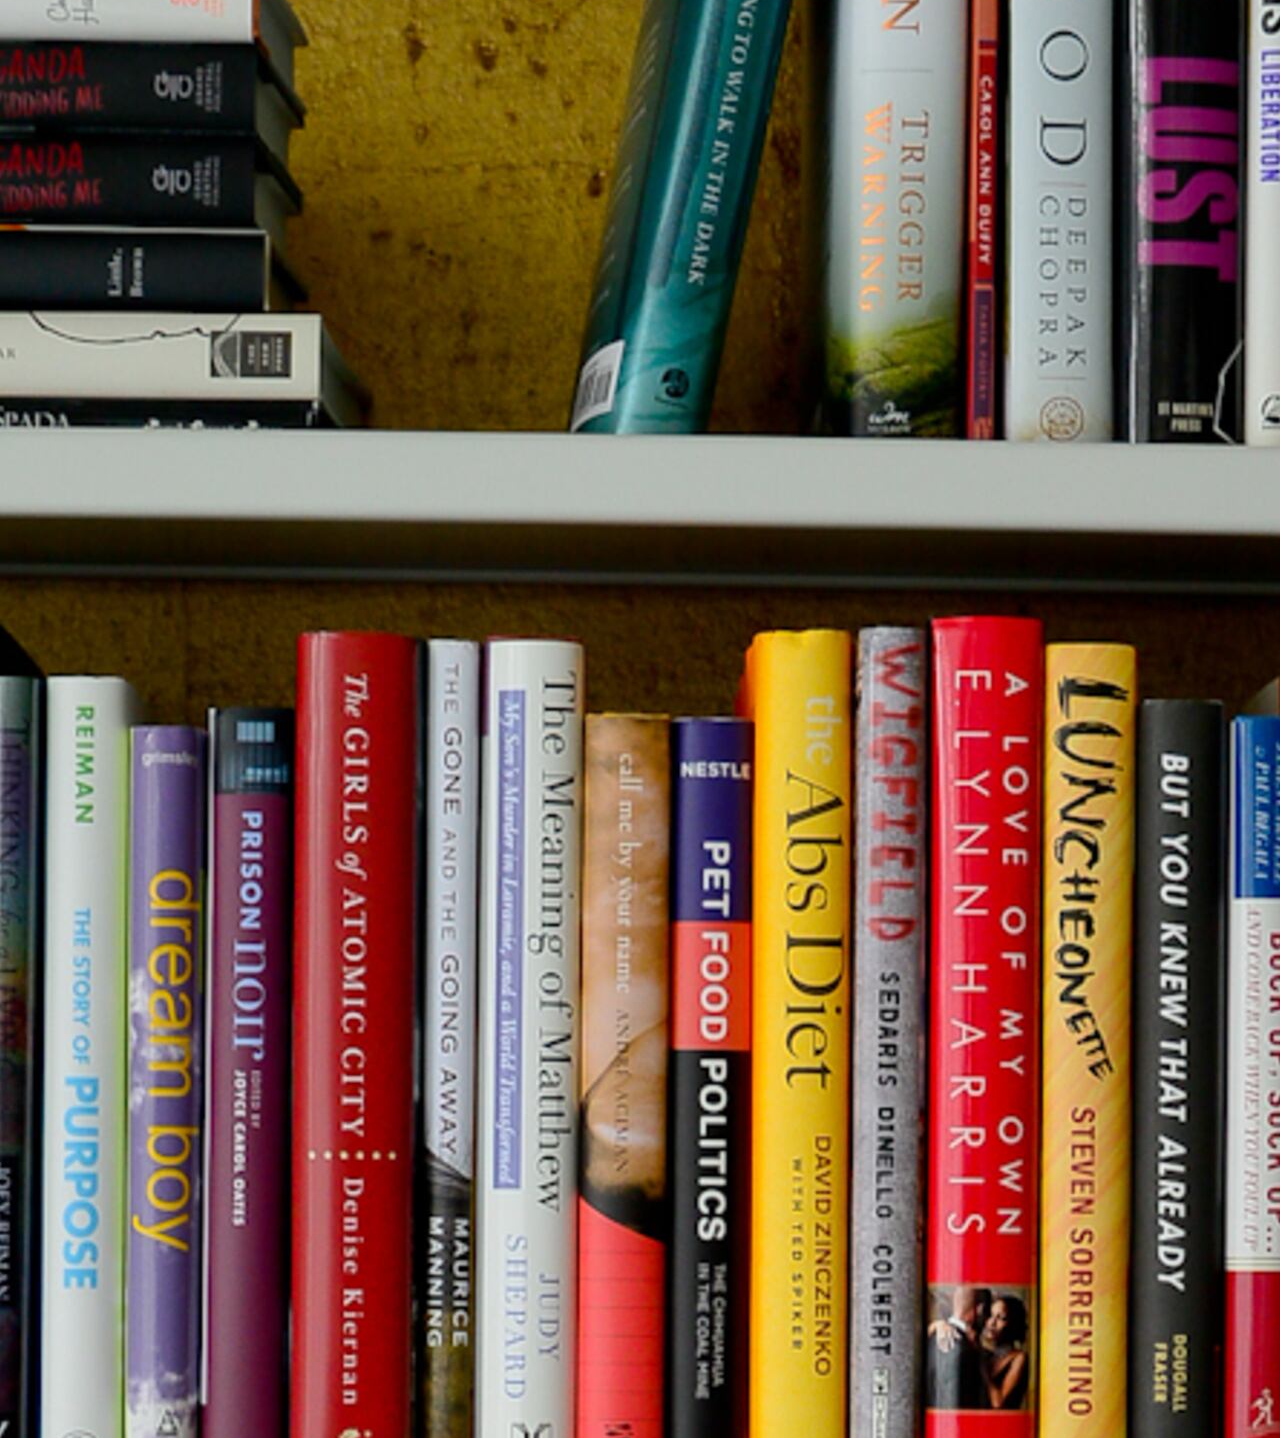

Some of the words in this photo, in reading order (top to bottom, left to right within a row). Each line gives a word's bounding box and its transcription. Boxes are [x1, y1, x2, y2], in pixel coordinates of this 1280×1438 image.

[73, 907, 93, 948] THE
[698, 841, 731, 916] PET
[73, 955, 93, 1026] STORY
[147, 868, 197, 1099] dream
[697, 930, 729, 1043] FOOD
[73, 1034, 92, 1066] OF
[61, 1077, 100, 1290] PURPOSE
[132, 1121, 195, 1254] boy
[695, 1059, 728, 1241] POLITICS
[340, 1177, 362, 1282] Denise
[339, 1296, 362, 1407] Kiernan
